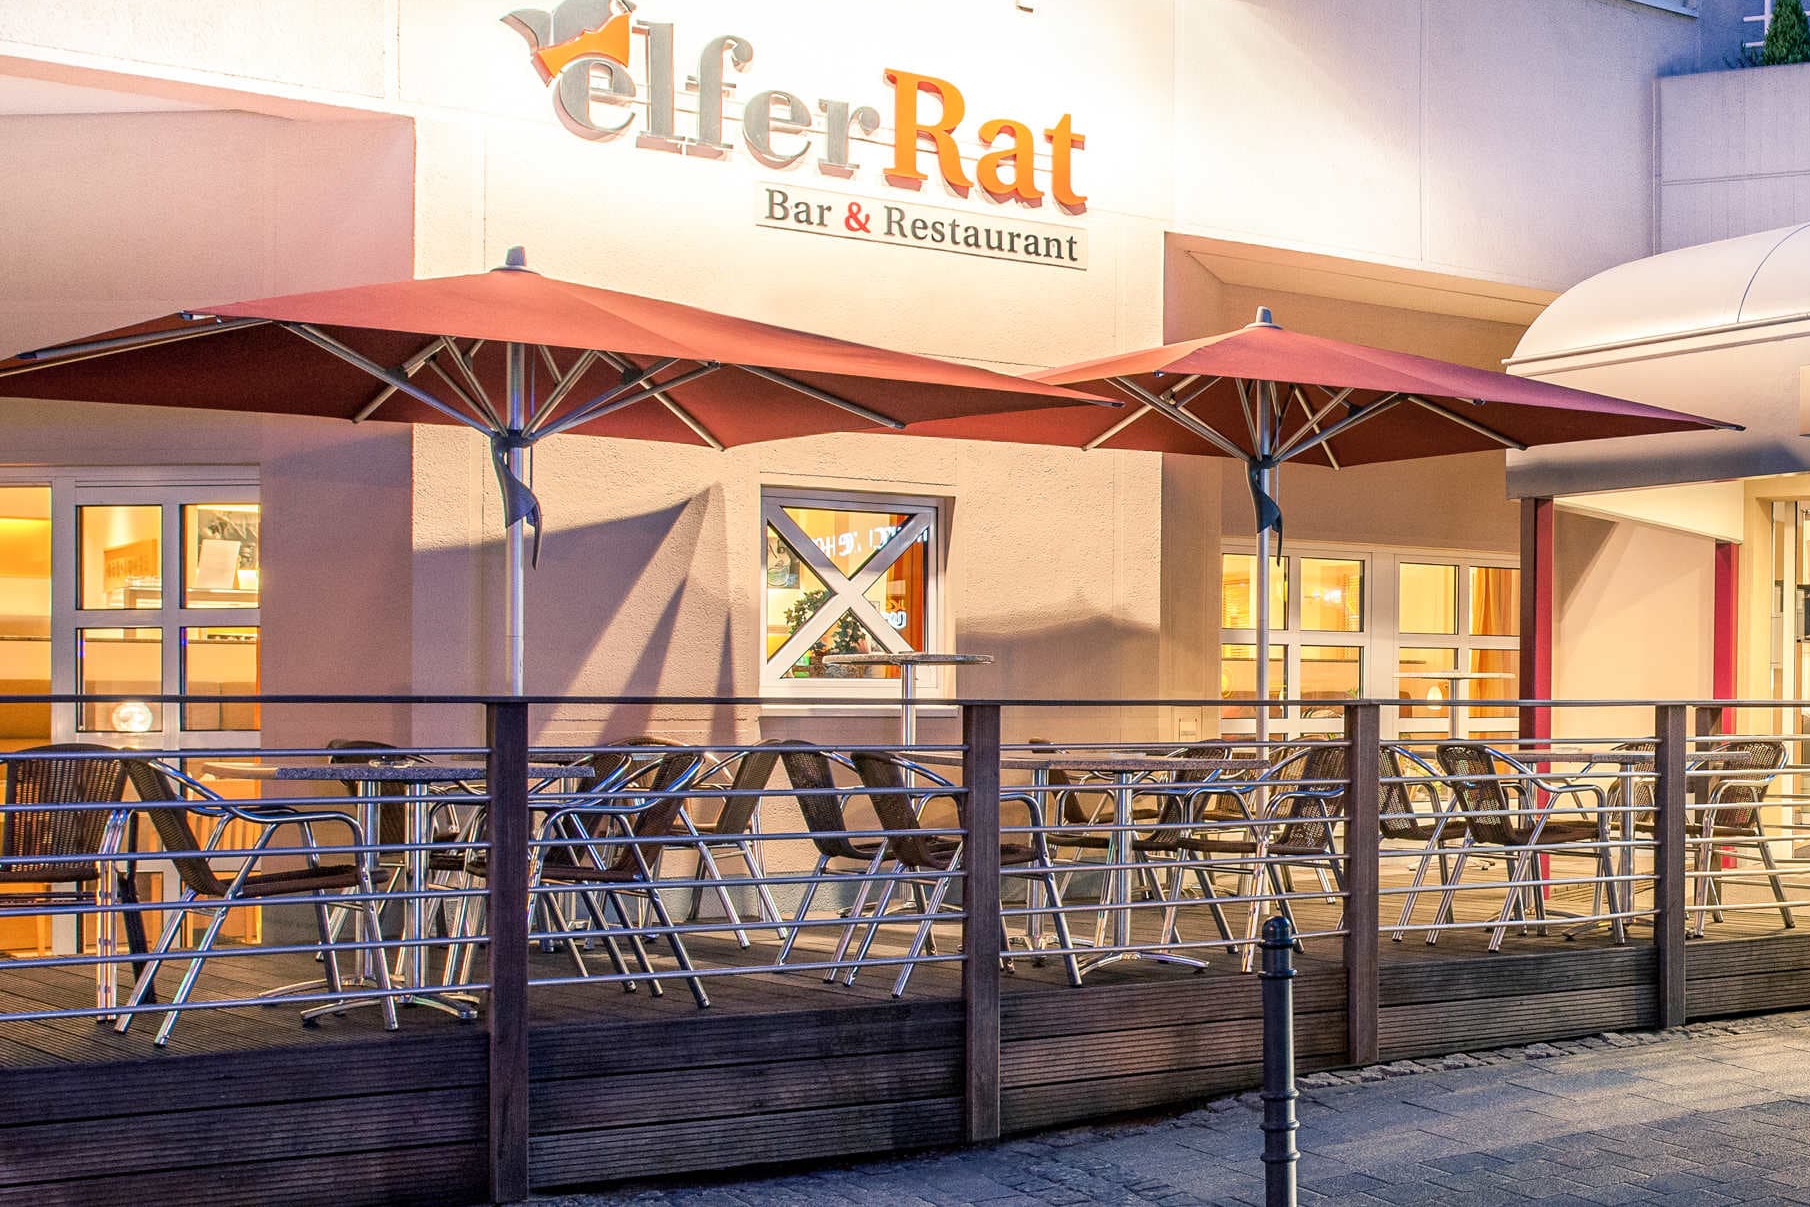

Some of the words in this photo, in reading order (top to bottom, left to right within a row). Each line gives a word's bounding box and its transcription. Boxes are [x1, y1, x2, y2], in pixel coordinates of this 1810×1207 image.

[554, 20, 1088, 212] elferRat
[764, 187, 832, 227] Bar
[844, 201, 872, 234] &
[883, 204, 1079, 262] Restaurant
